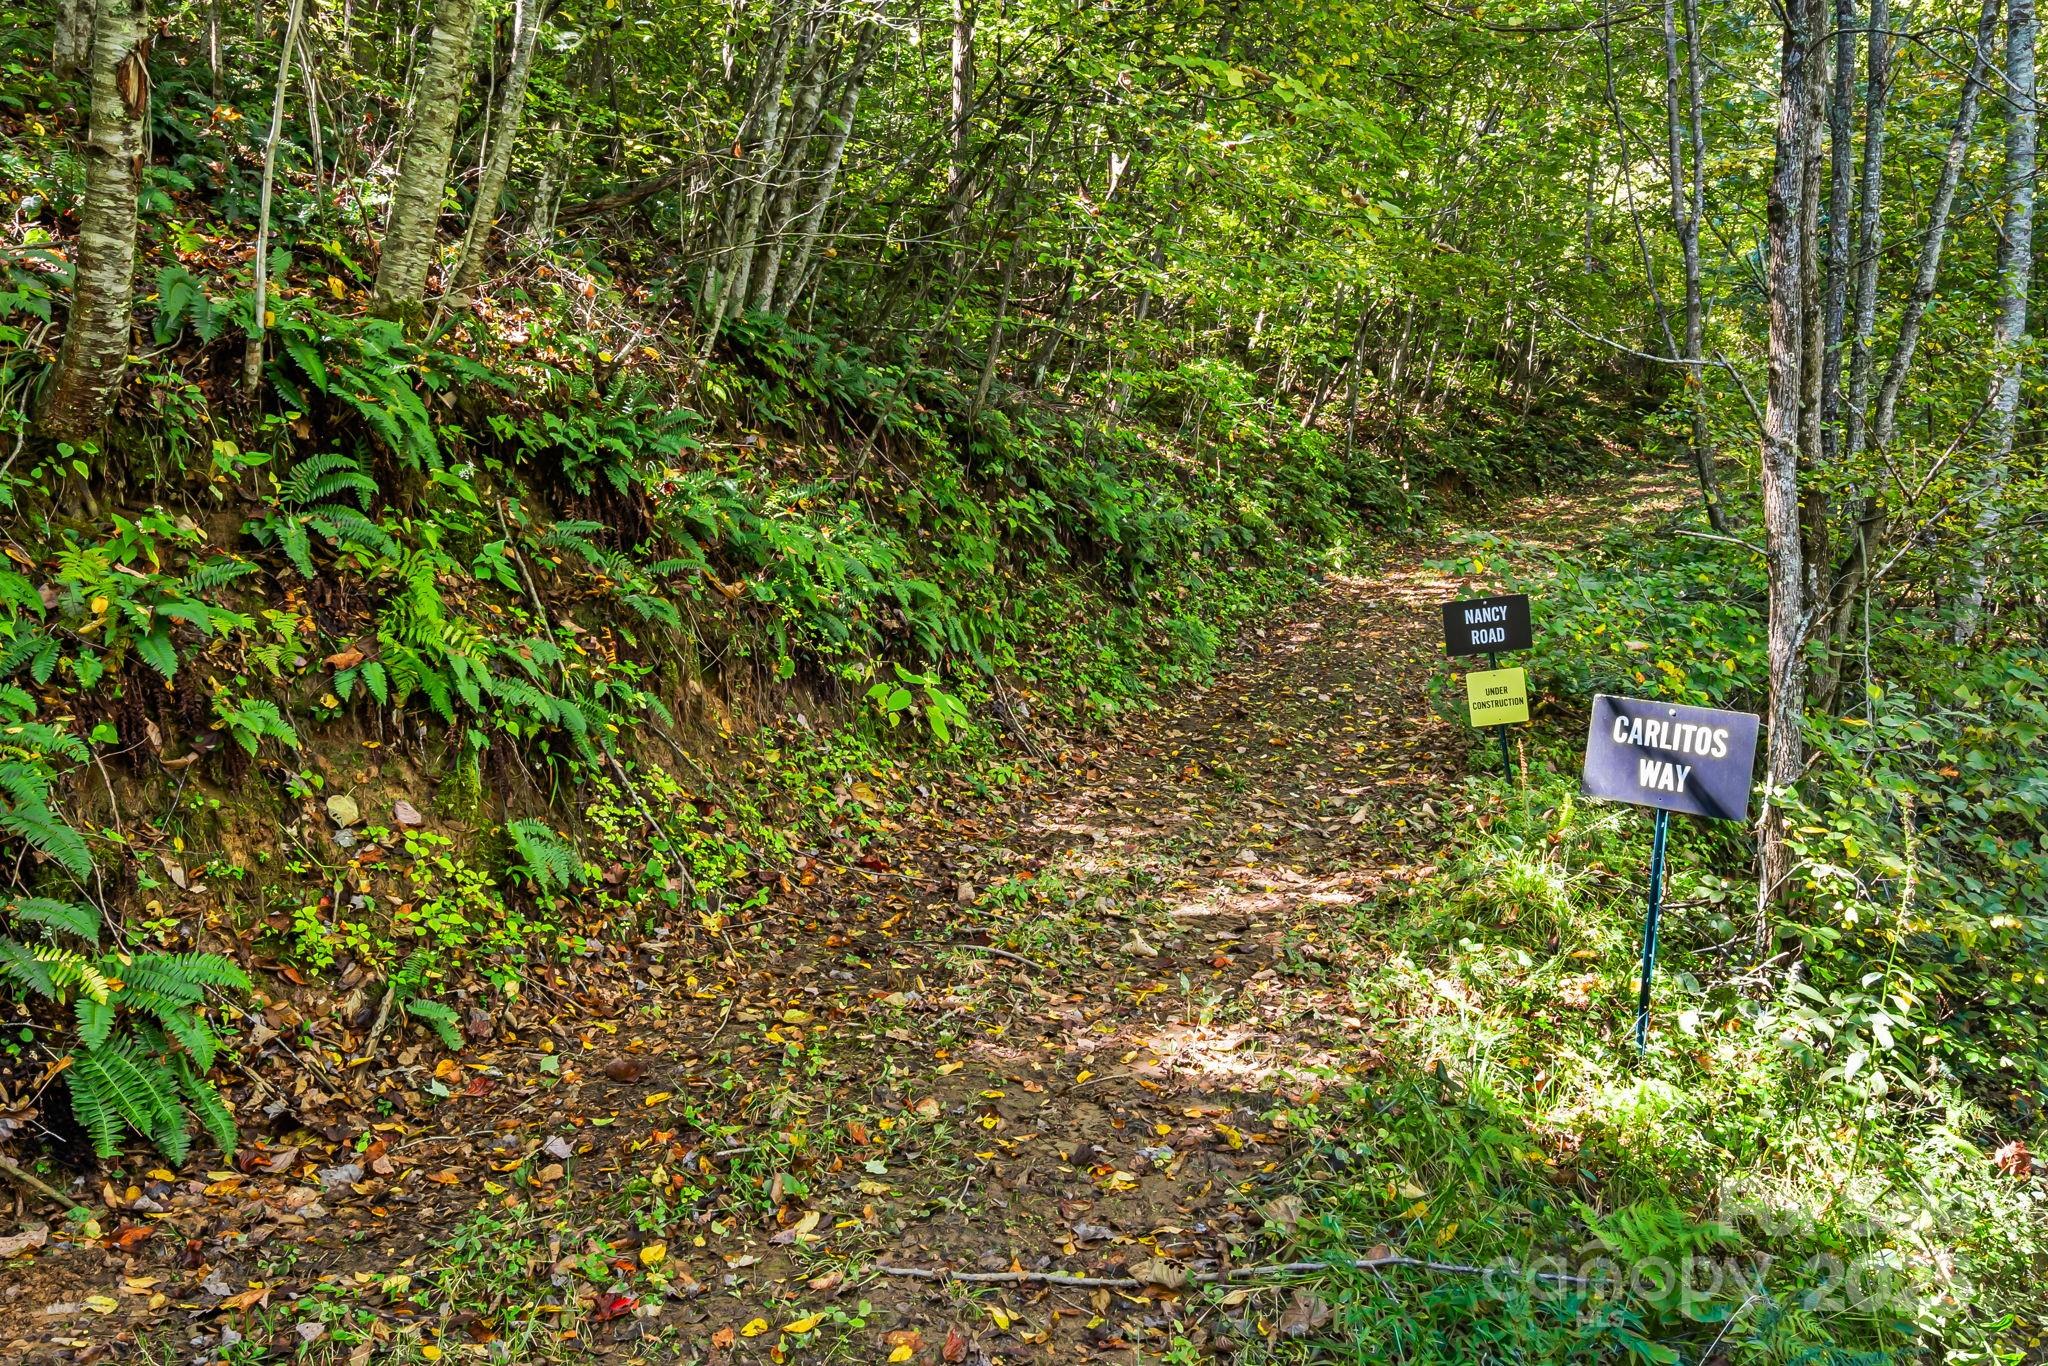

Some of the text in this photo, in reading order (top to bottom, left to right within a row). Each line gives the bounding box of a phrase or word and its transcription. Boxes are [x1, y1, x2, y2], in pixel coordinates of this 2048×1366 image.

[1464, 605, 1507, 625] NANCY
[1471, 627, 1505, 645] ROAD
[1485, 686, 1508, 696] UNDER
[1472, 697, 1524, 710] CONSTRUCTION
[1613, 715, 1728, 758] CARLITOS
[1639, 759, 1691, 792] WAY
